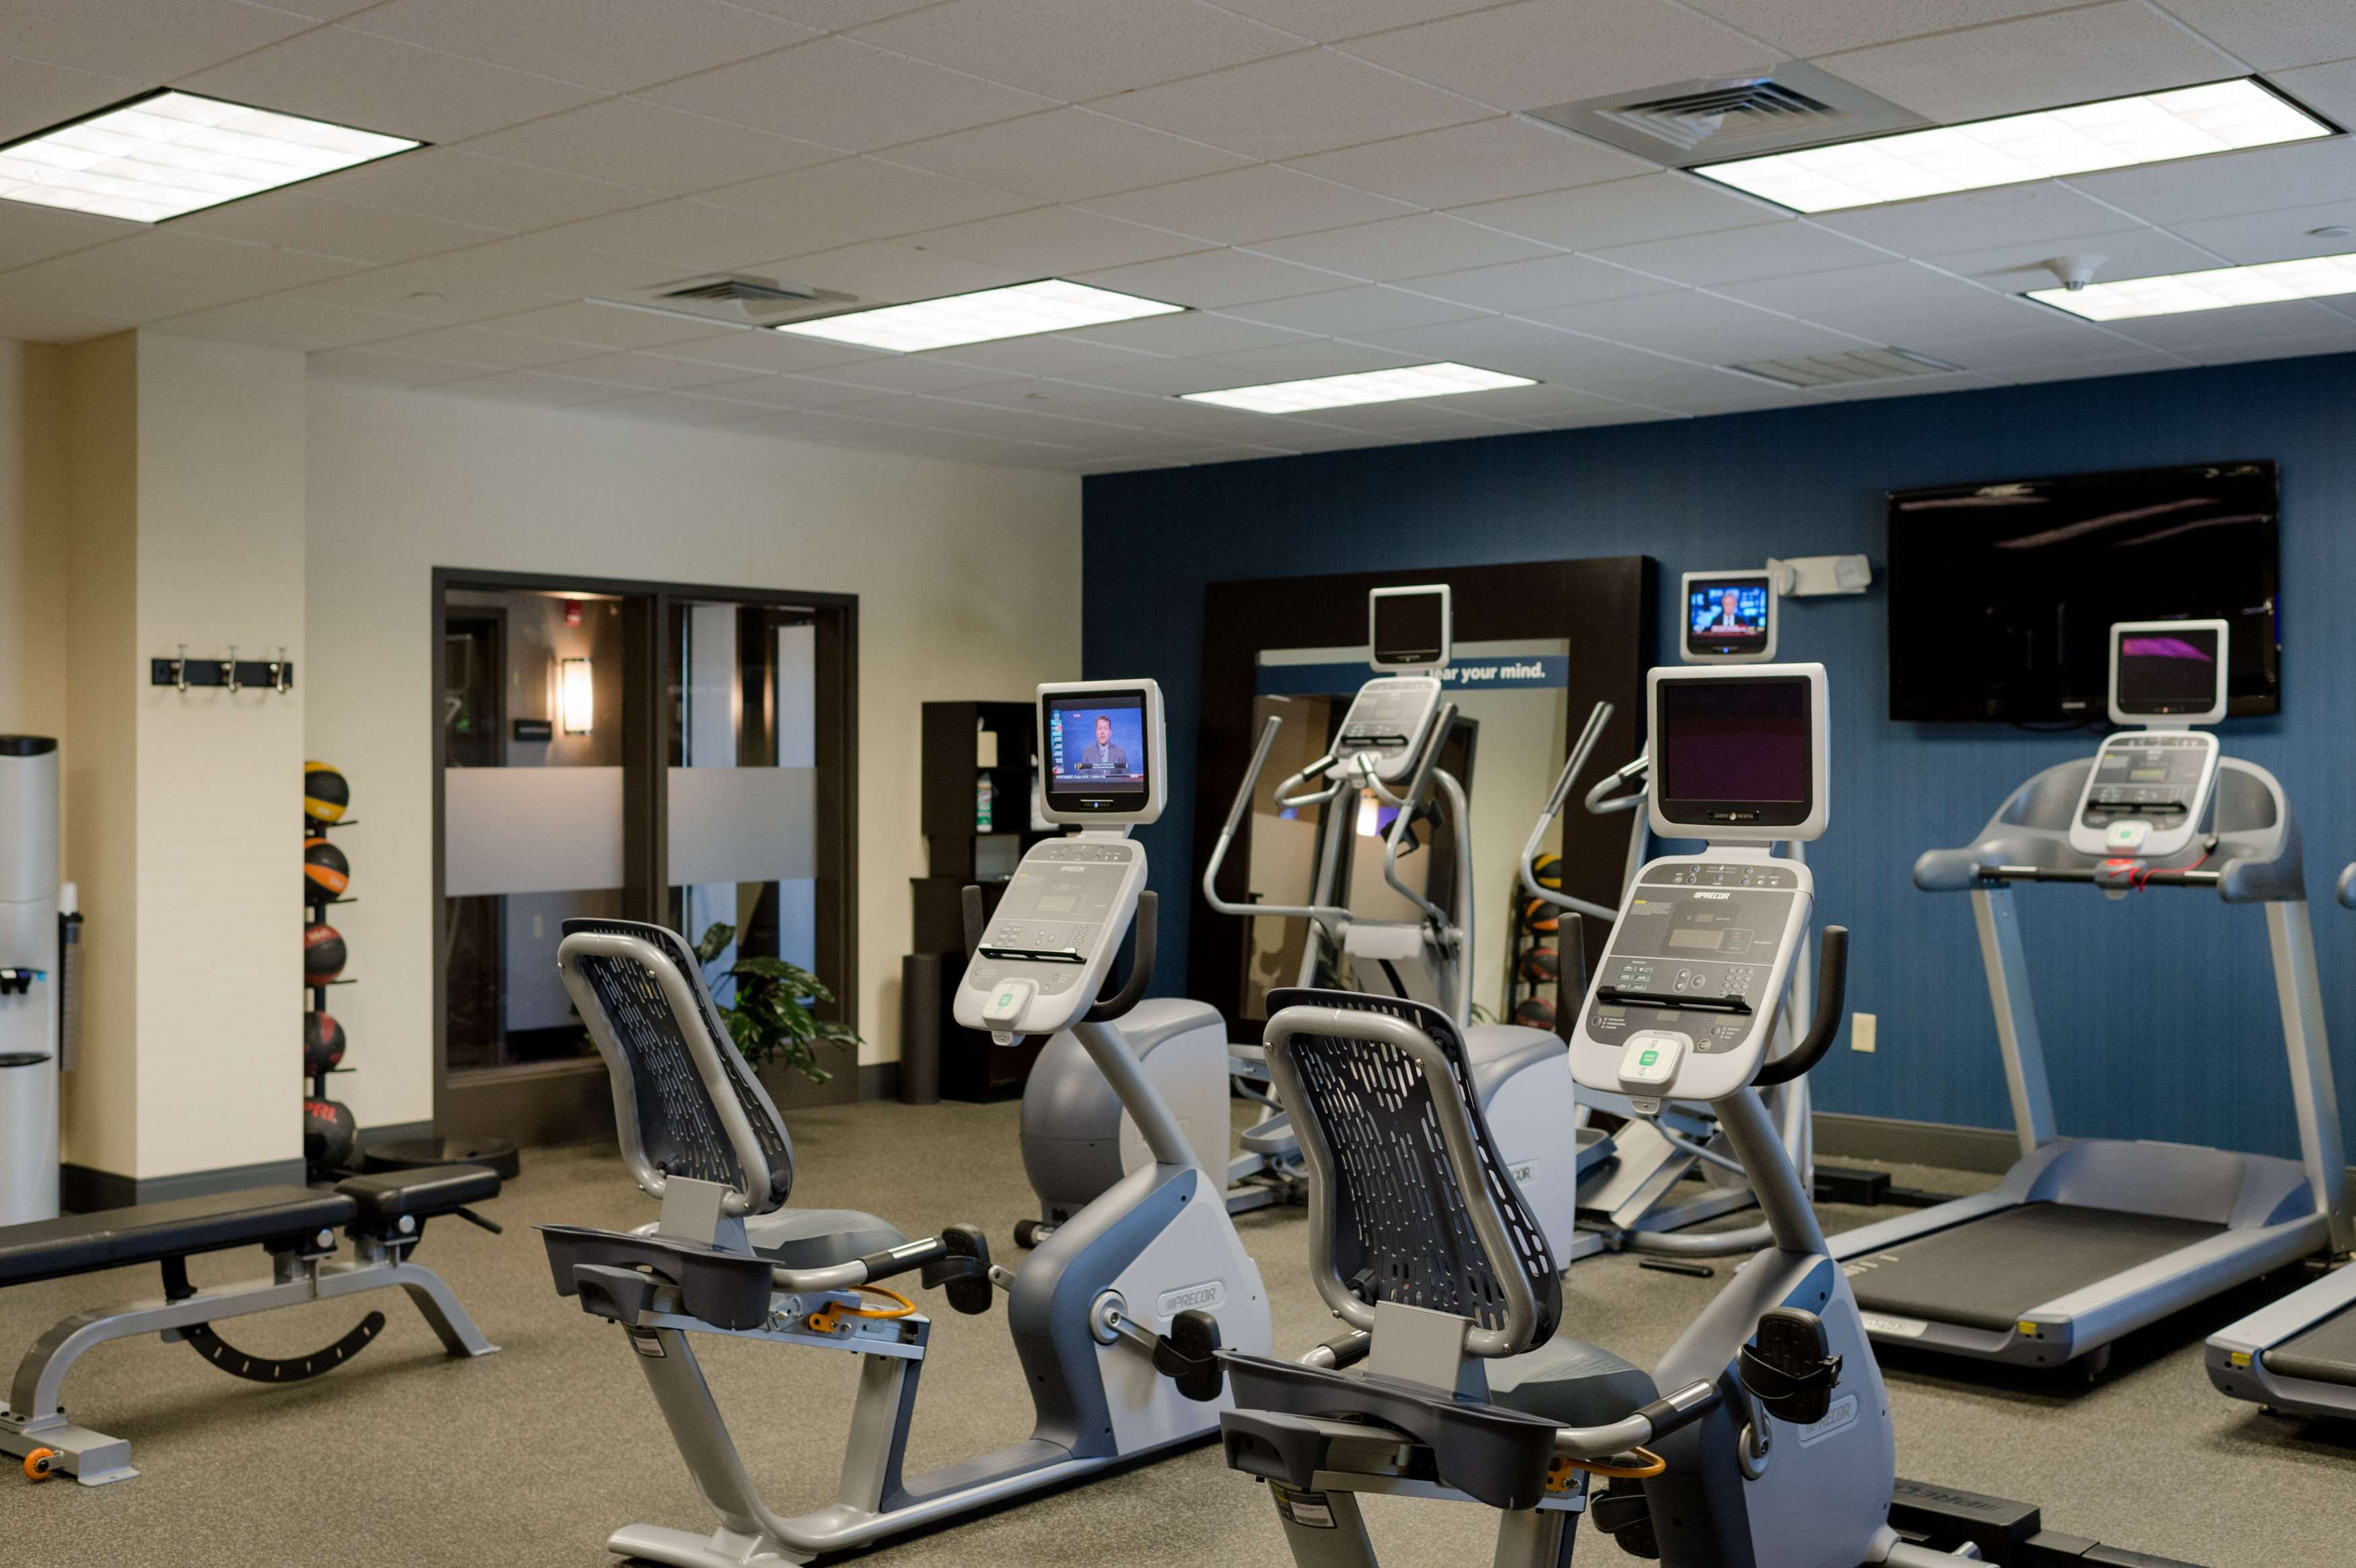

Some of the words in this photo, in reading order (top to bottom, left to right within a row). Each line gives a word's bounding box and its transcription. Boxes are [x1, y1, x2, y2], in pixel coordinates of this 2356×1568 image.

[1461, 667, 1497, 684] your
[1500, 662, 1546, 679] mind.
[1698, 892, 1730, 900] PRECOR
[1173, 1287, 1216, 1309] PRECOR
